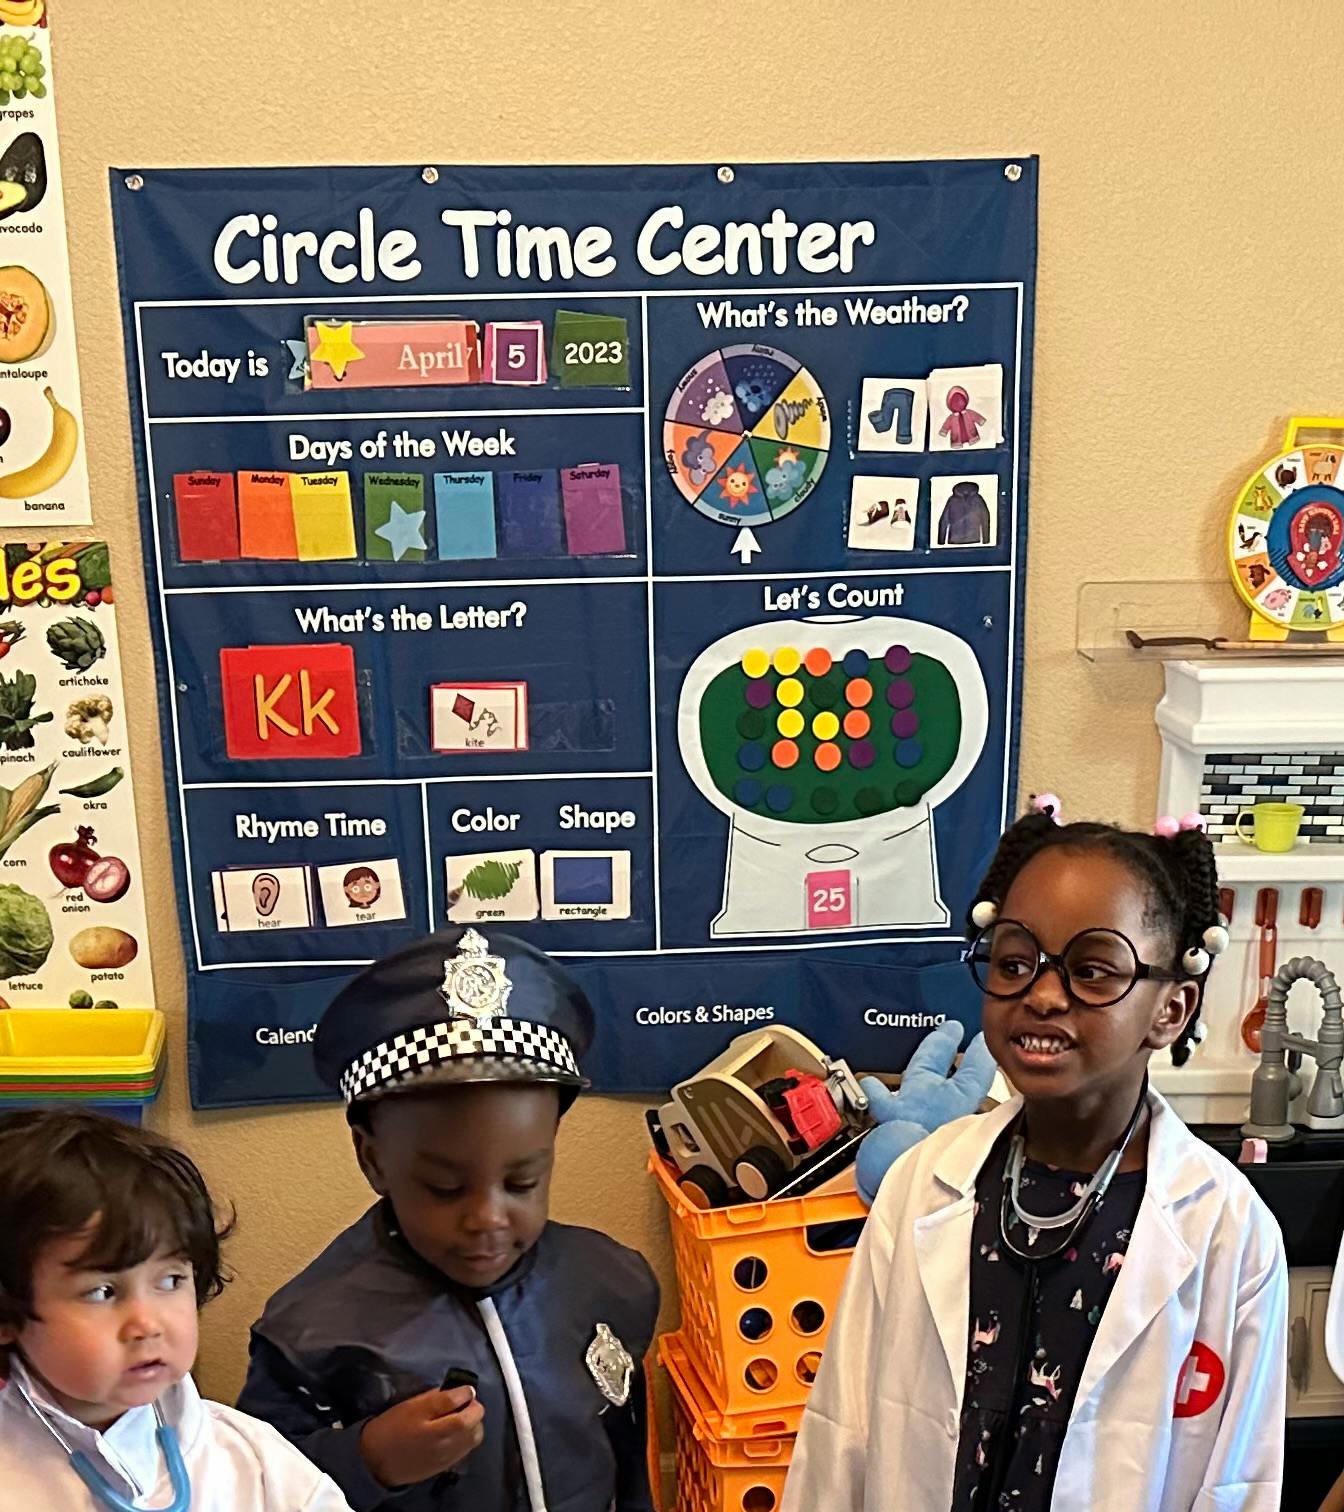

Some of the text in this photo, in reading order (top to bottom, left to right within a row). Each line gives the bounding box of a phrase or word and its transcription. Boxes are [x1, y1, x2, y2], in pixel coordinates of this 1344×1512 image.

[214, 206, 874, 284] Circle Time Center
[697, 295, 968, 328] What's the Weather?
[399, 343, 462, 376] April
[508, 345, 525, 368] 5
[565, 342, 622, 364] 2023
[162, 350, 268, 383] Today is
[289, 429, 515, 465] Days of the Week
[188, 476, 220, 487] Sunday
[252, 475, 284, 486] Monday
[301, 476, 337, 486] Tuesday
[368, 474, 420, 488] Wednesday
[443, 475, 484, 485] Thursday
[570, 469, 610, 480] Saturday
[24, 501, 65, 510] banana
[765, 583, 904, 610] Let's Count
[295, 602, 526, 633] What's the Letter?
[59, 676, 108, 686] artichoke
[253, 670, 339, 741] Kk
[465, 737, 485, 748] kite
[63, 747, 121, 757] cauliflower
[452, 807, 520, 832] Color
[560, 804, 635, 833] Shape
[236, 813, 386, 843] Rhyme Time
[814, 888, 845, 912] 25
[356, 910, 376, 922] tear
[476, 910, 505, 919] green
[559, 905, 607, 917] rectangle
[257, 917, 281, 928] hear
[9, 982, 43, 990] lettuce
[91, 973, 124, 983] potato
[636, 1005, 774, 1024] Colors & Shapes
[864, 1009, 947, 1029] Counting
